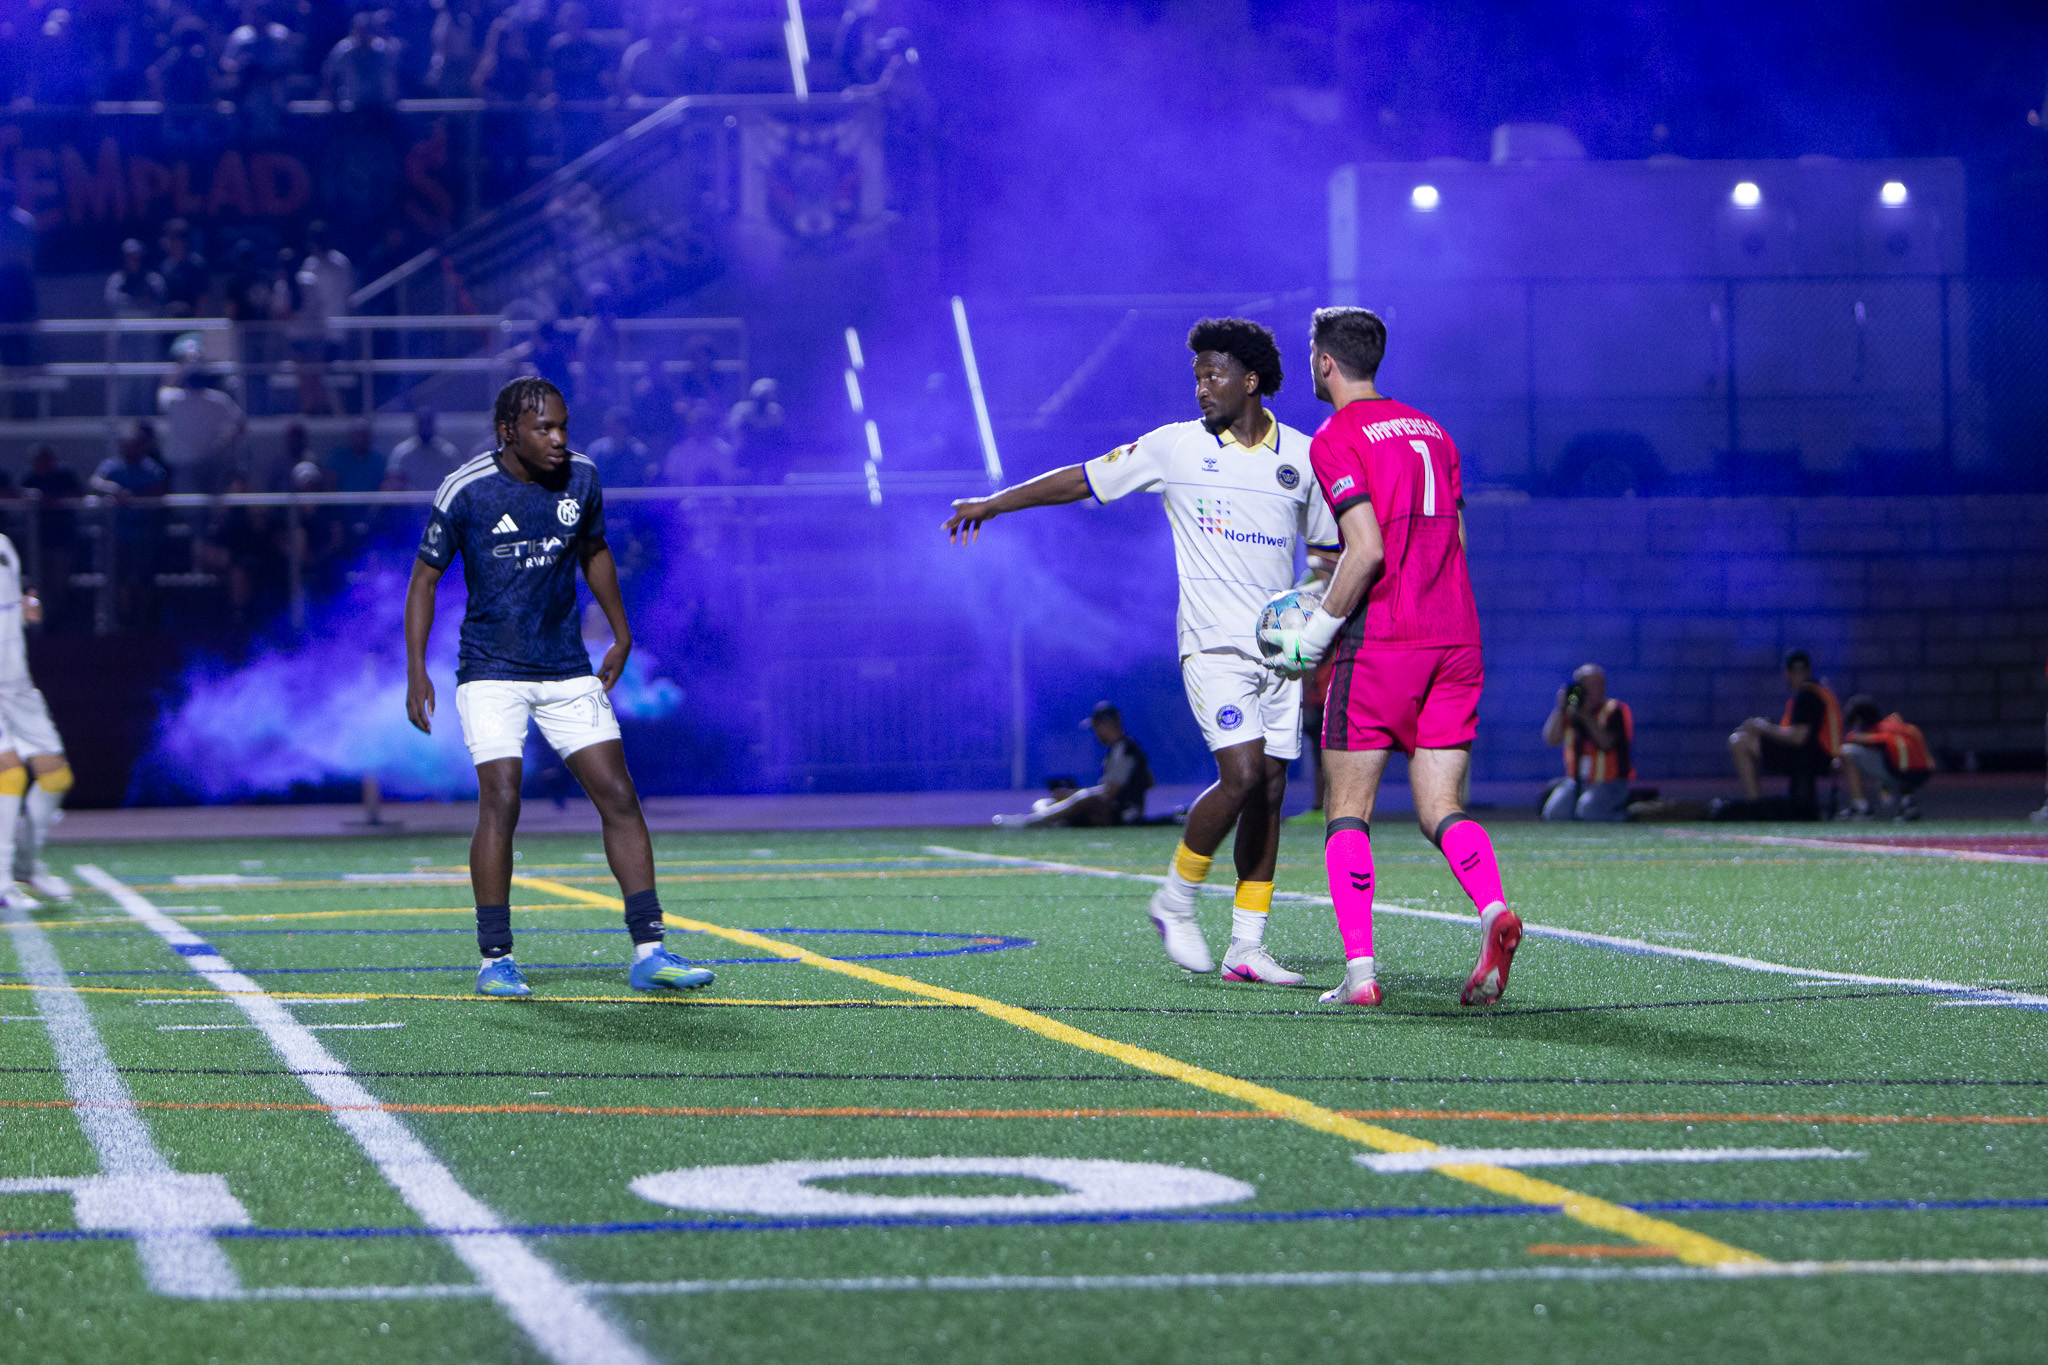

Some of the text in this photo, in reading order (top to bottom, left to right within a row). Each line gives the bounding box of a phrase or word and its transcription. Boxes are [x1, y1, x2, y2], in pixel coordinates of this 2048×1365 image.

[1361, 417, 1444, 444] HAMMERSLEY
[1408, 440, 1436, 517] 1
[514, 554, 561, 570] AIRWAY
